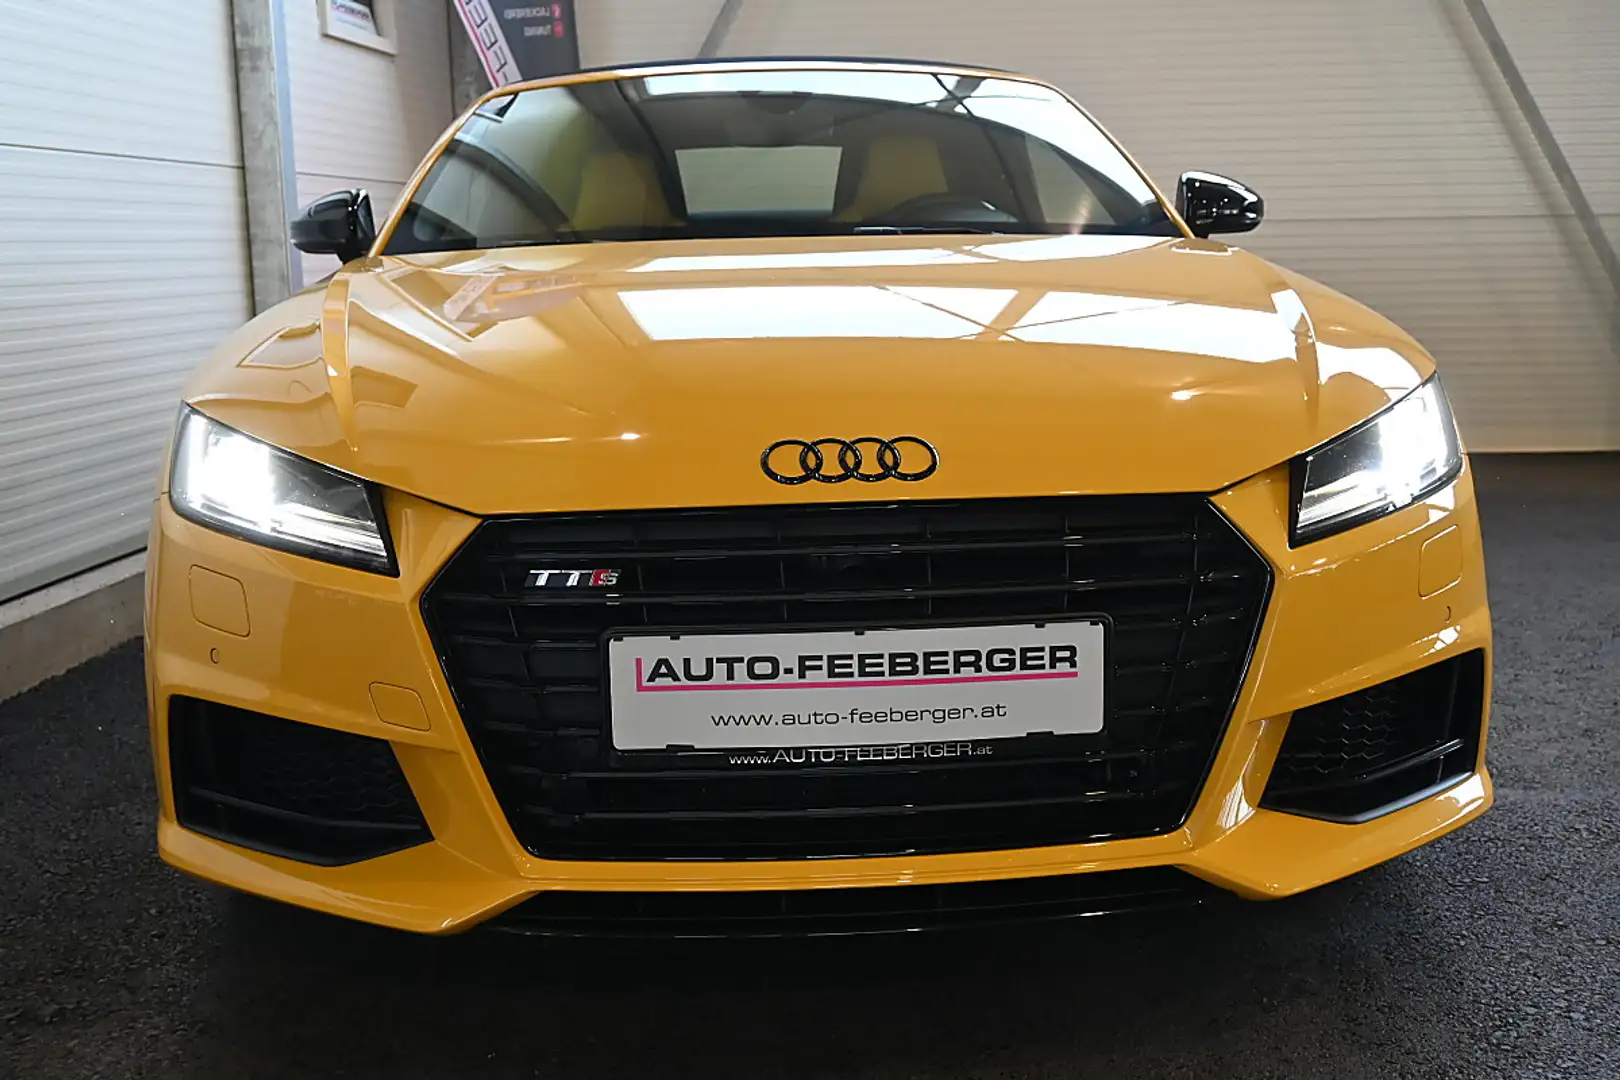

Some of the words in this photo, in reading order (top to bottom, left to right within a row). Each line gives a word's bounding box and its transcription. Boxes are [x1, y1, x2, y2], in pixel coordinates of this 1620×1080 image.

[529, 569, 620, 587] TTS
[646, 645, 1078, 683] AUTO-FEEBERGER
[711, 703, 1007, 726] www.auto-feeberger.at
[728, 742, 994, 764] www.AUTO-FEEBERGER.at
